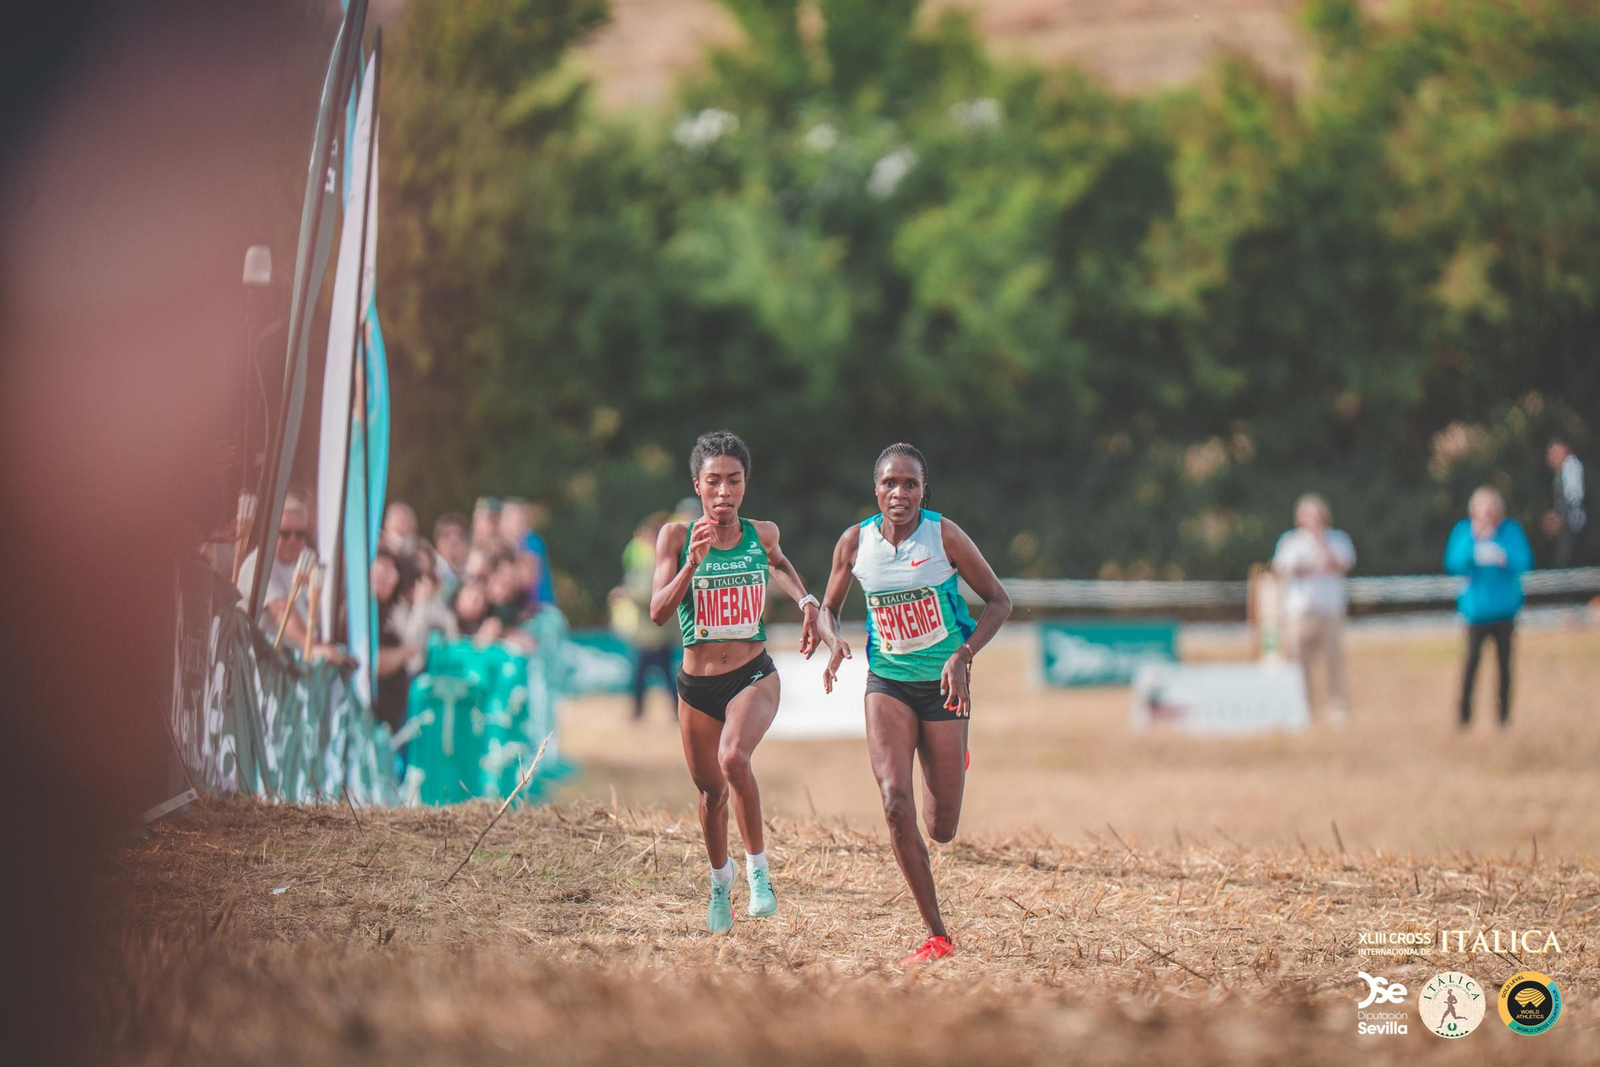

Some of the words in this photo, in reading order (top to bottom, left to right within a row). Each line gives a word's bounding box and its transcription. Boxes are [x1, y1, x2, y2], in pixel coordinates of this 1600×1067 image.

[713, 576, 748, 587] ITÁLICA
[882, 592, 917, 605] ITÁLICA
[696, 585, 763, 627] AMEBAW
